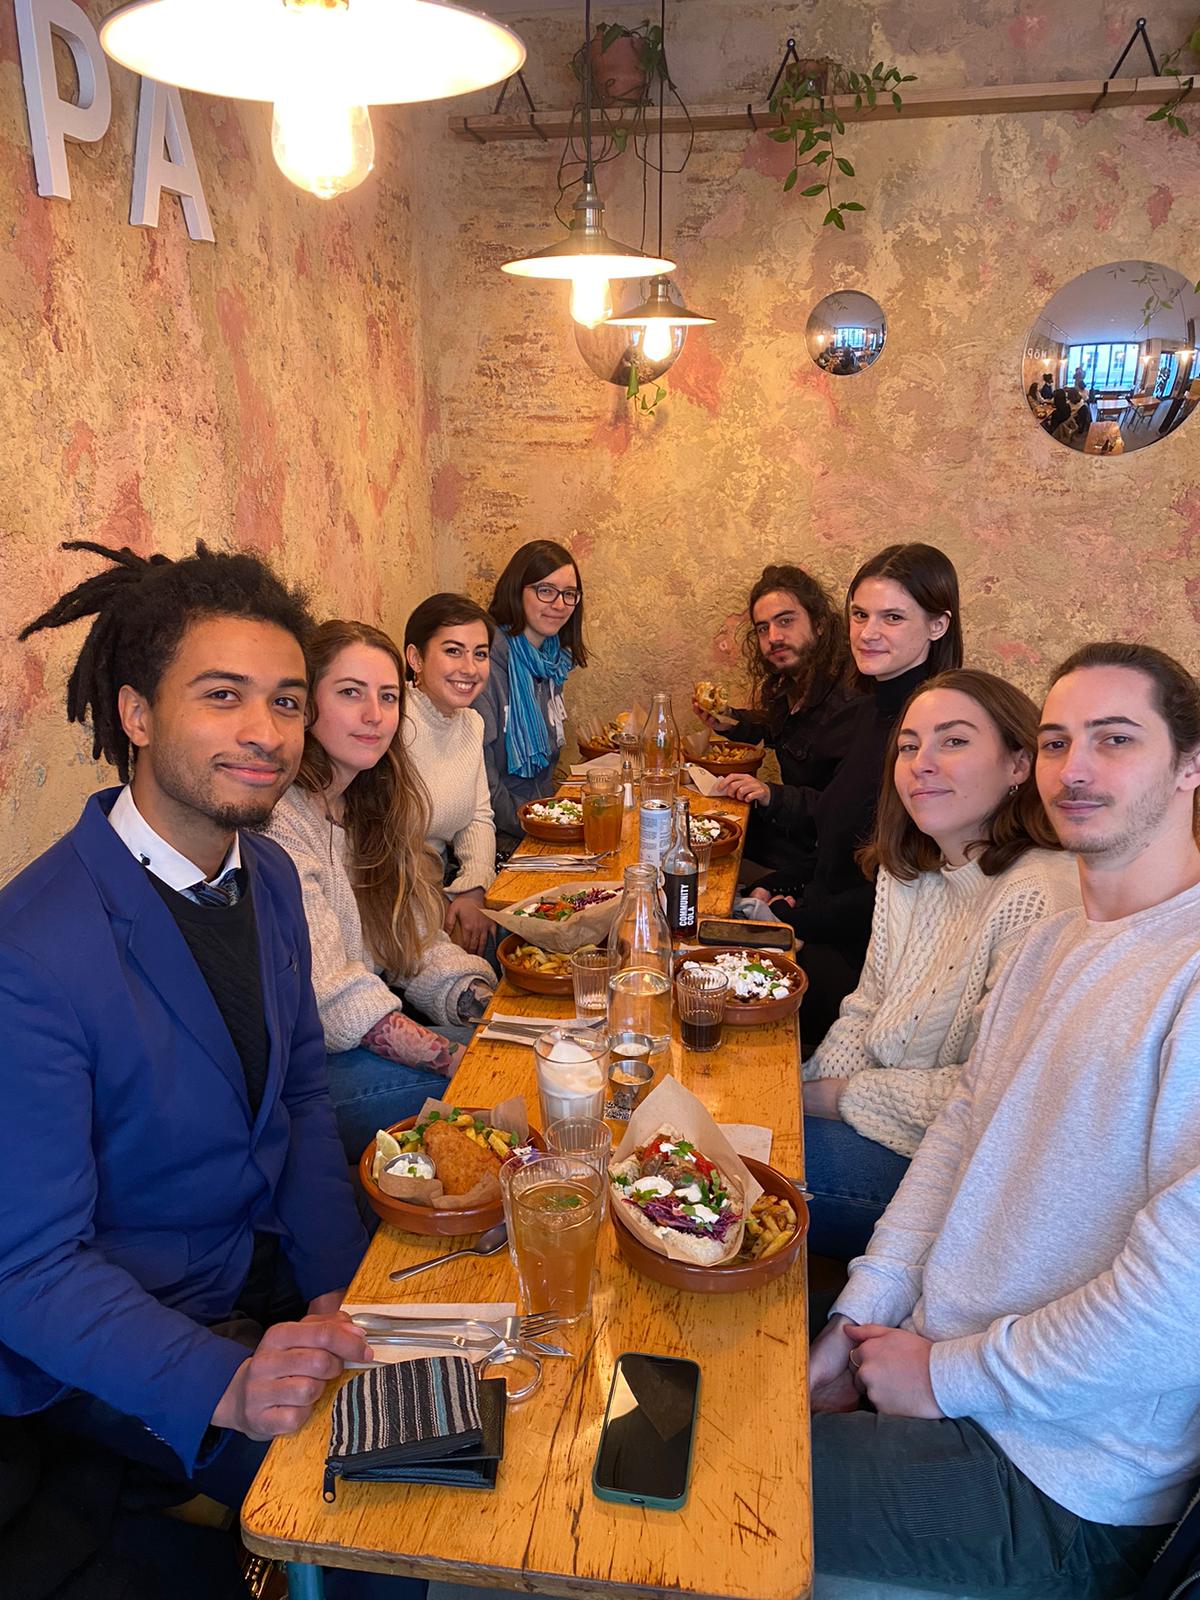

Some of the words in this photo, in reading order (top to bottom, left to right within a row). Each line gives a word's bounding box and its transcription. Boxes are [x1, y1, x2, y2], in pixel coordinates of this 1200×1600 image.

[15, 0, 215, 243] PA
[679, 884, 689, 926] COMMUNITY
[687, 906, 695, 926] COLA
